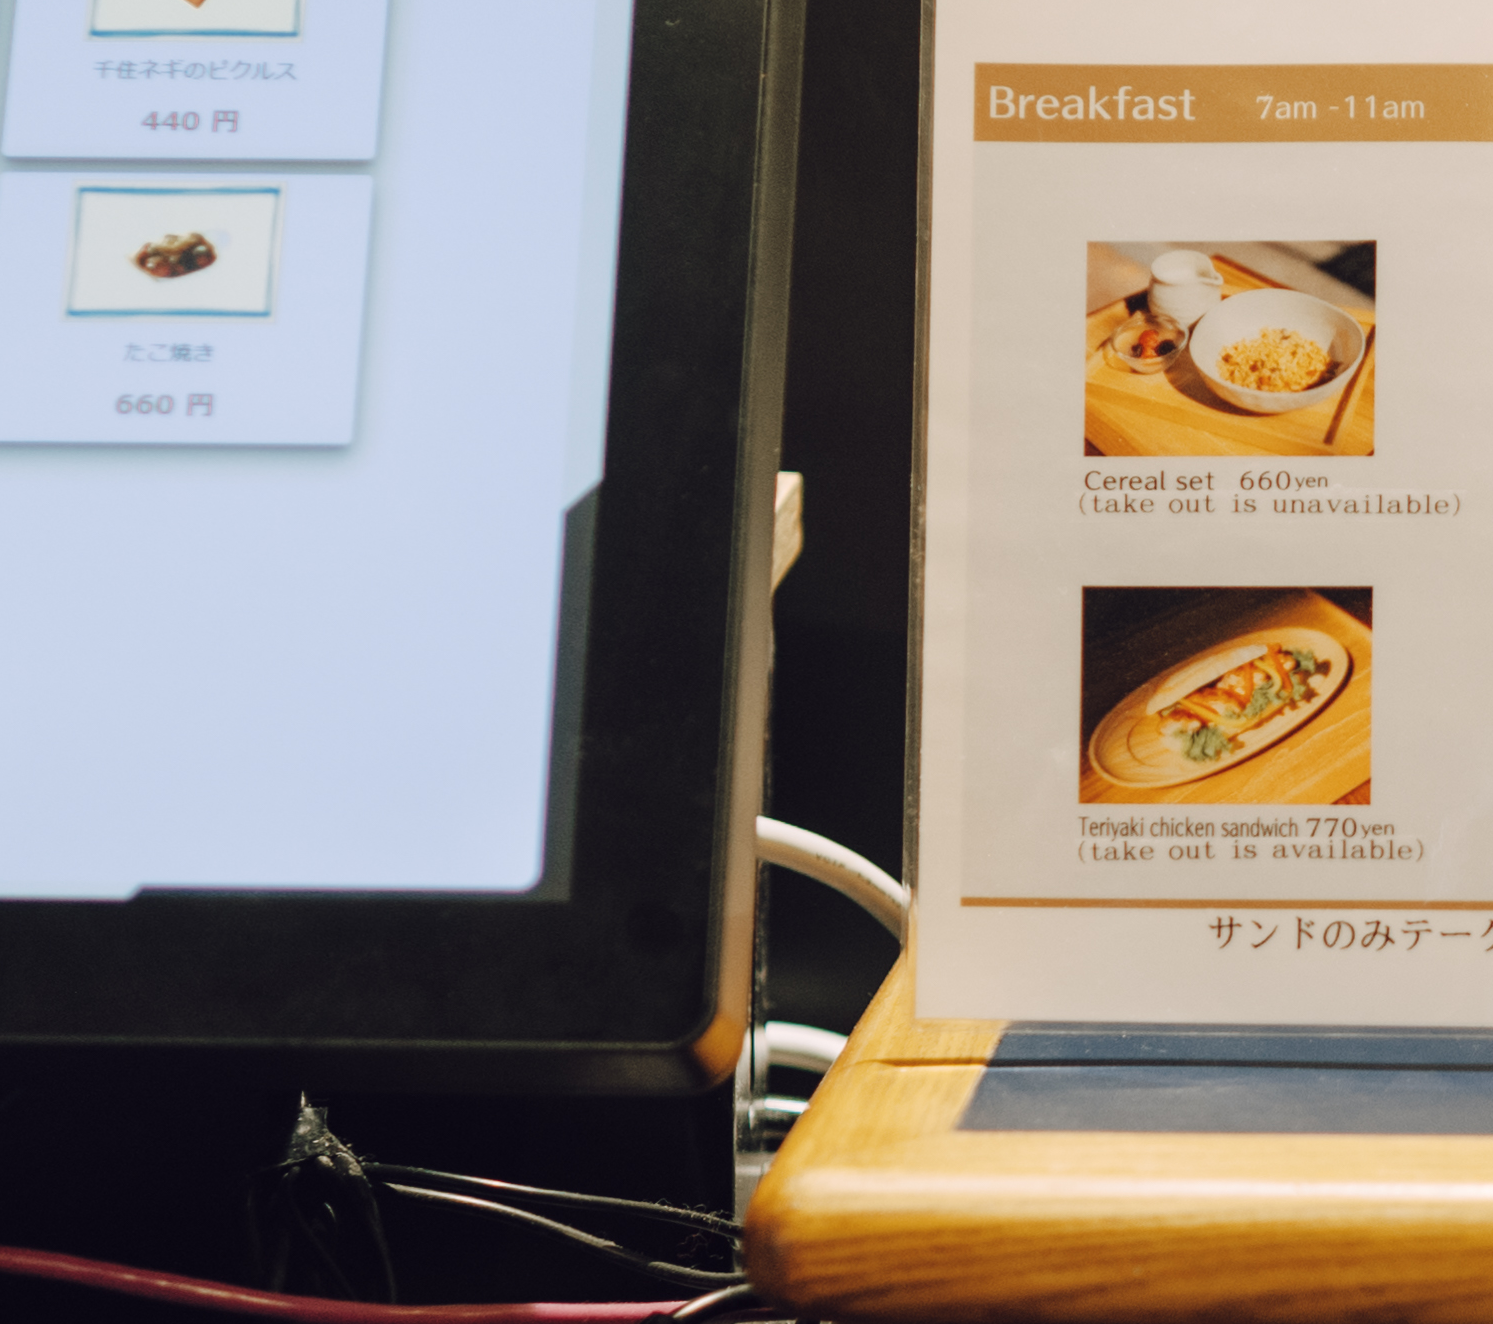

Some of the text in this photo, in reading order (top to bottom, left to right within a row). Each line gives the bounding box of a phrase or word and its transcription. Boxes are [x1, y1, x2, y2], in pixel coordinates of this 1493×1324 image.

[989, 84, 1196, 122] Breakfast
[1255, 93, 1318, 121] 7am
[1083, 470, 1167, 493] Cereal
[1175, 471, 1214, 492] set
[1078, 492, 1461, 516] (take out is unavailable)
[1080, 815, 1144, 838] Teriyaki
[1149, 816, 1215, 839] chicken
[1220, 817, 1299, 839] sandwich
